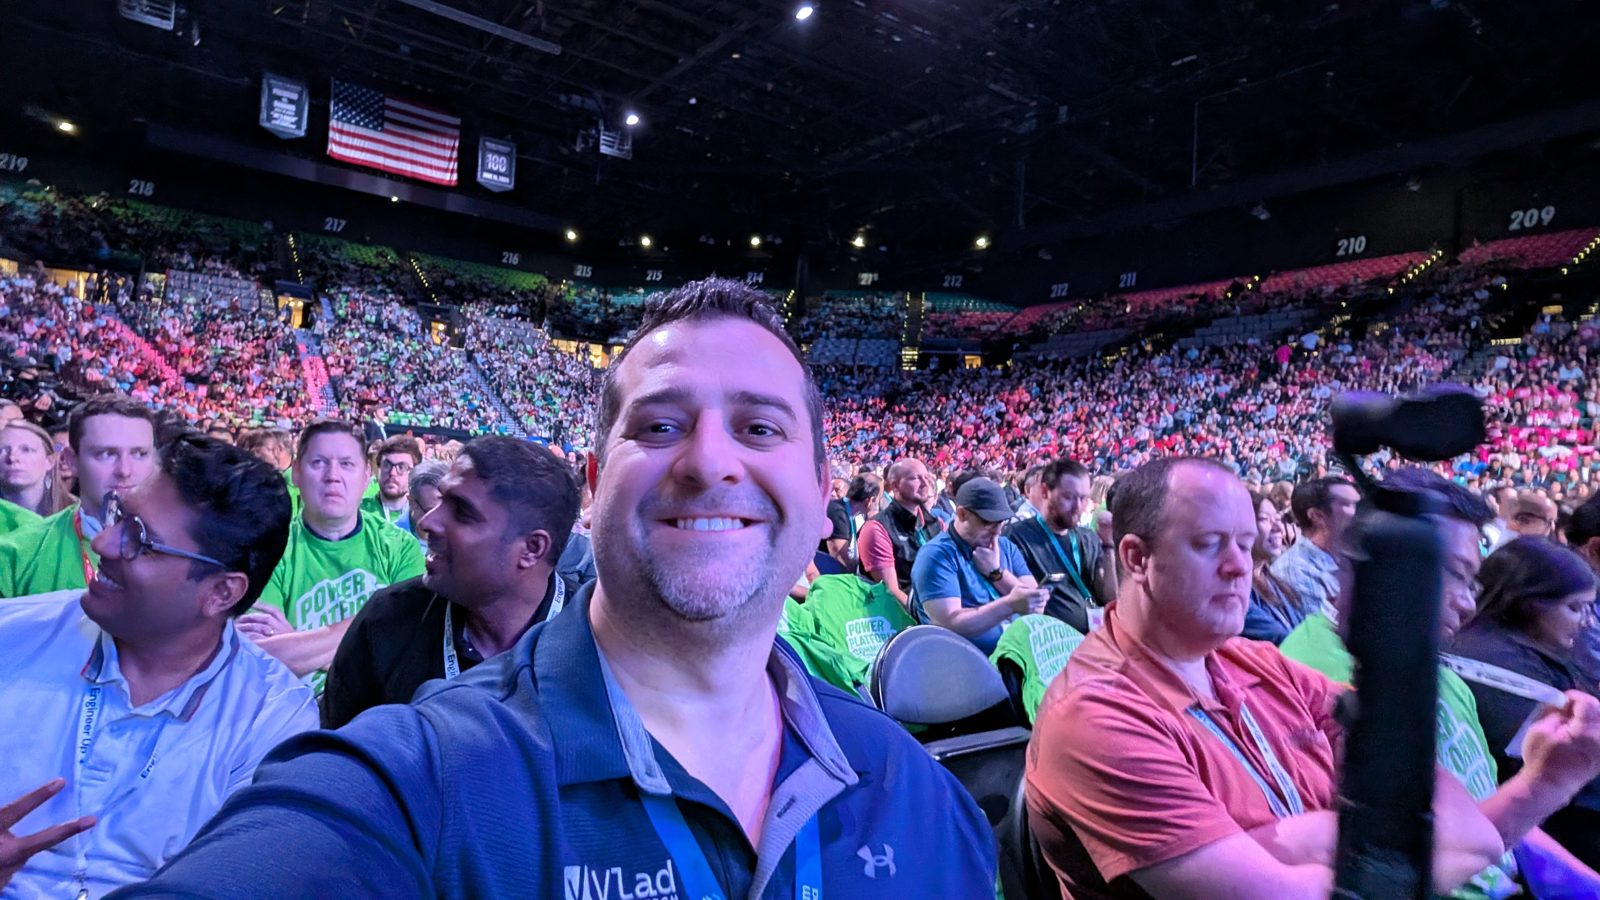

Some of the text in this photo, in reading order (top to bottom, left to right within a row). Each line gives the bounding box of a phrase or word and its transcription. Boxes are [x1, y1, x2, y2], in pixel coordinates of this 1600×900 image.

[0, 153, 28, 172] 219
[128, 179, 155, 196] 218
[324, 216, 347, 232] 217
[1508, 205, 1556, 231] 209
[1336, 235, 1366, 257] 210
[502, 251, 519, 265] 216
[575, 265, 592, 278] 215
[646, 270, 662, 281] 215
[1119, 272, 1136, 288] 211
[943, 275, 962, 288] 212
[1050, 283, 1069, 298] 212
[301, 573, 365, 626] POWER
[848, 619, 884, 636] POWER
[83, 687, 100, 735] Engineer
[591, 859, 676, 900] Vlad
